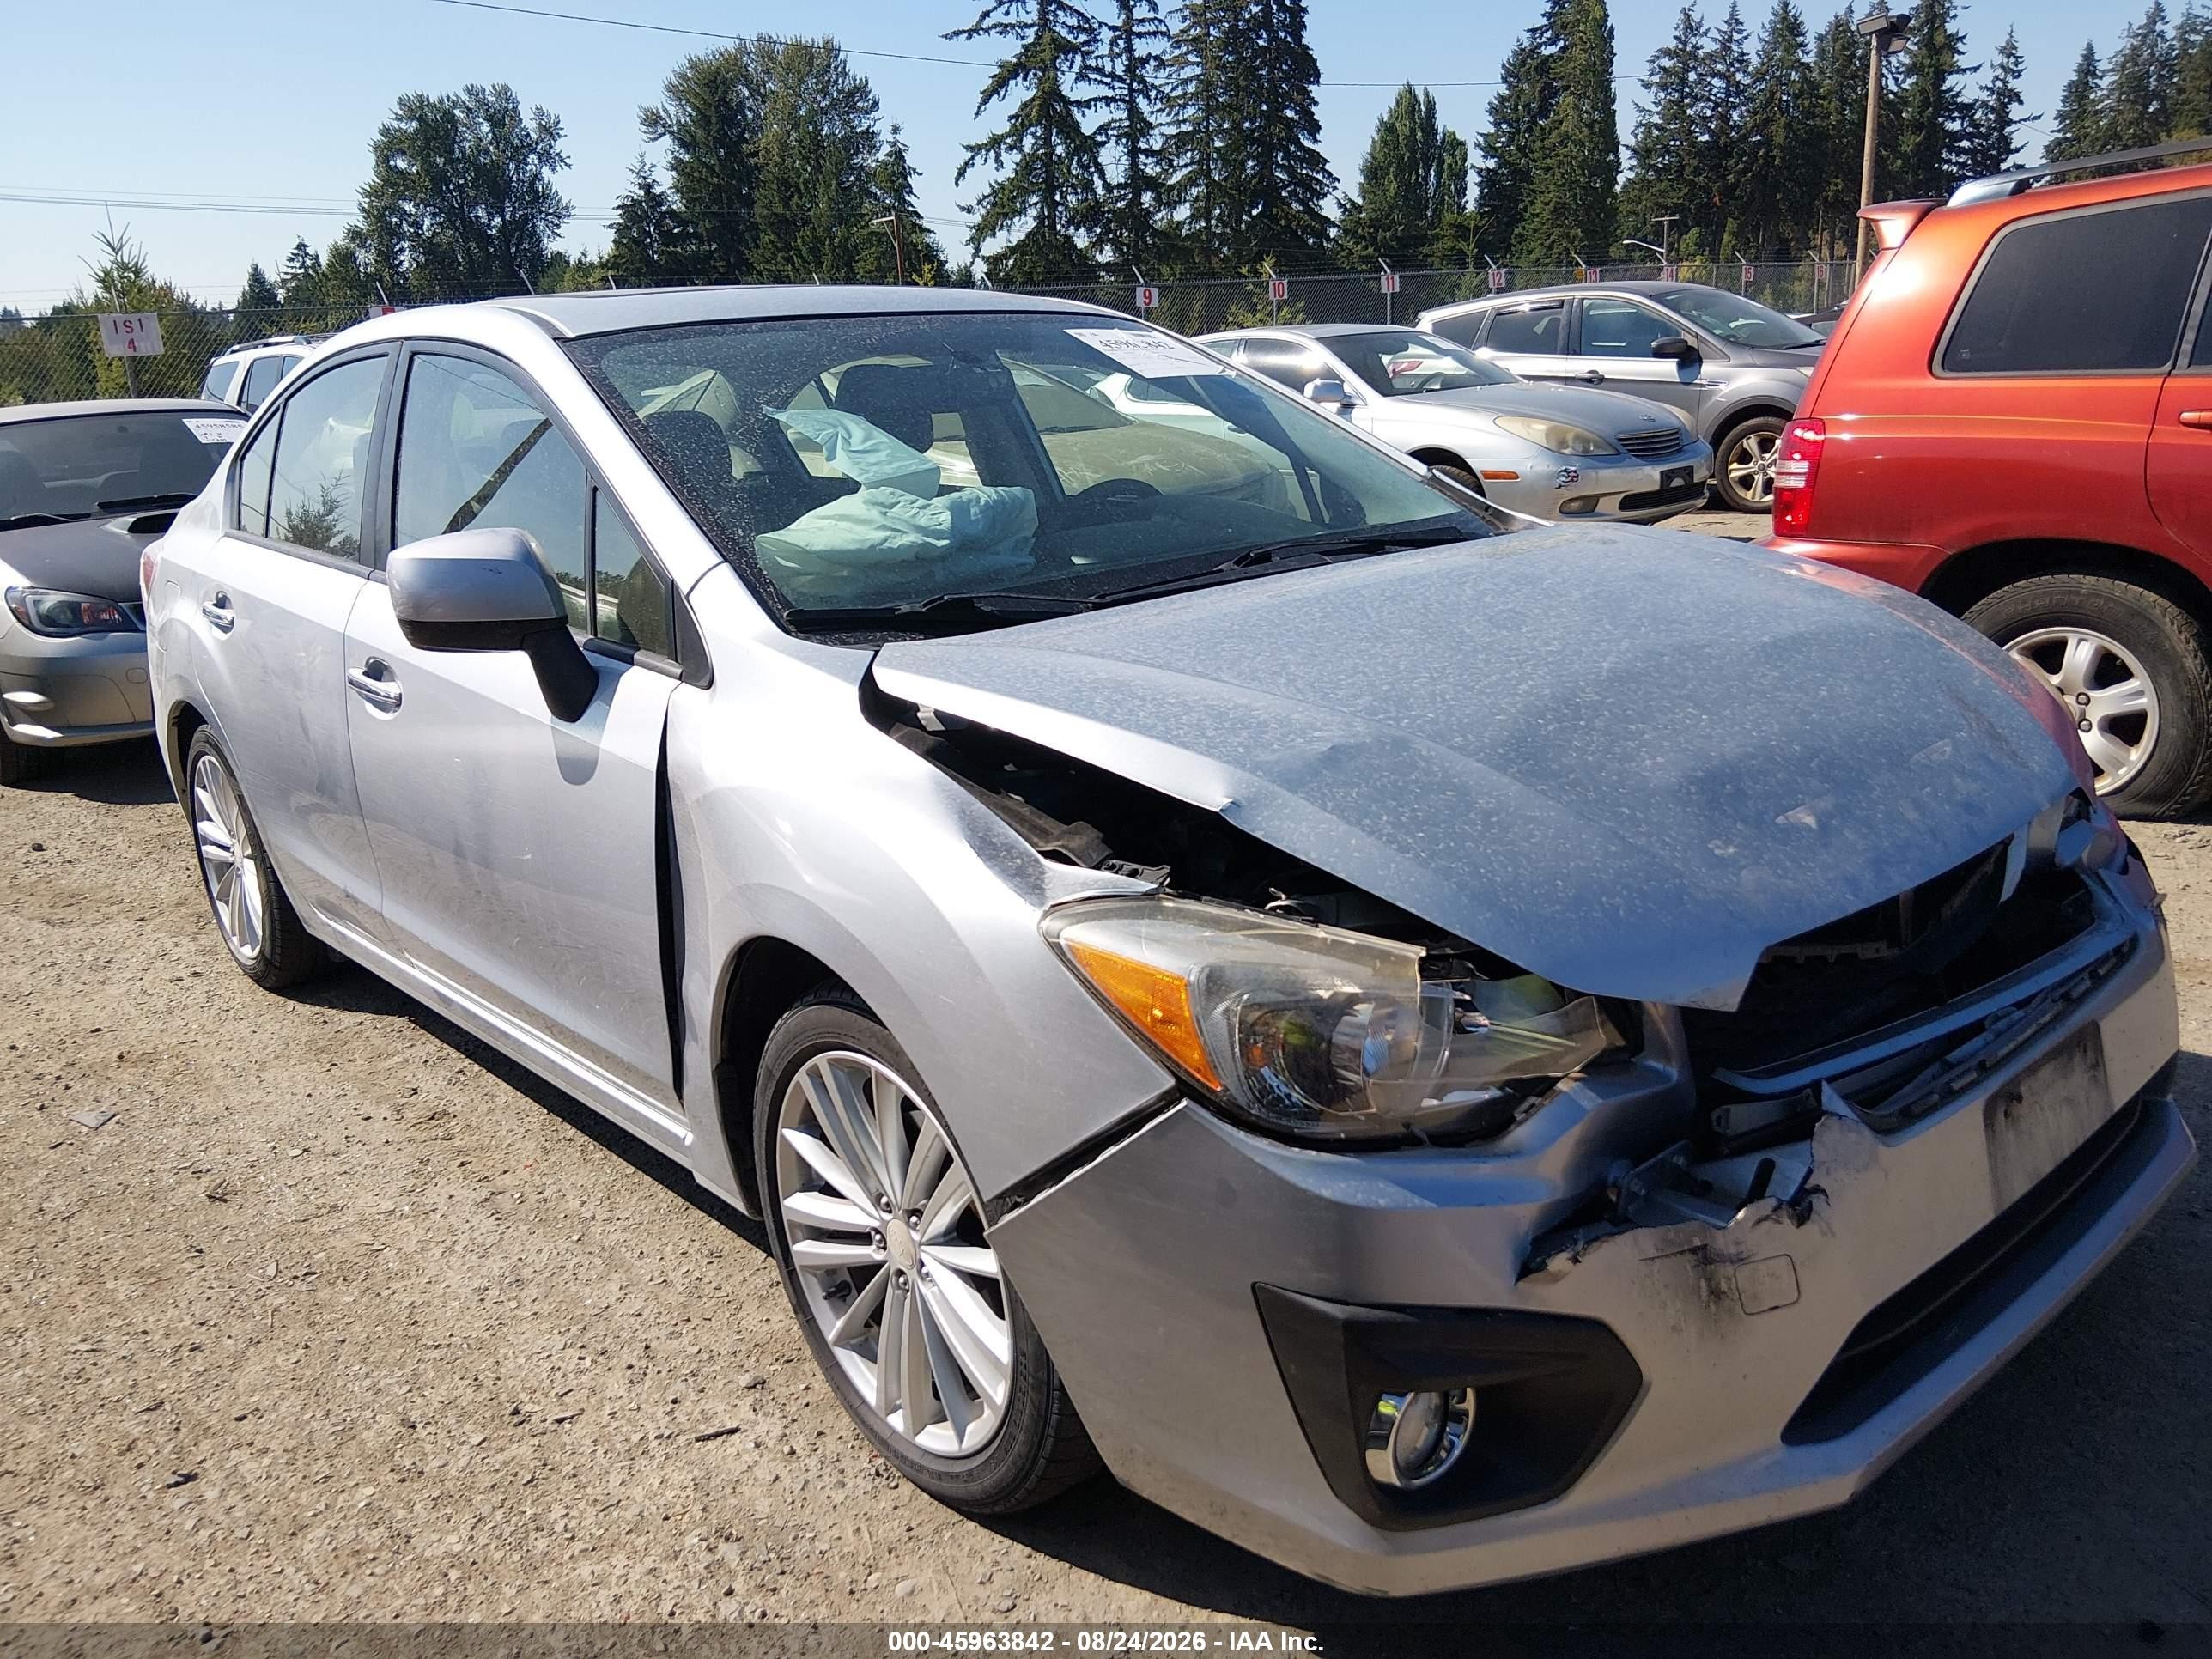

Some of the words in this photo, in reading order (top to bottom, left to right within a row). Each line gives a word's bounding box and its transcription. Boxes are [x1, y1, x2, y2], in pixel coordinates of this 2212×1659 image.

[1589, 270, 1597, 283] 13
[1666, 267, 1674, 281] 14
[1744, 267, 1753, 280] 15
[1817, 265, 1824, 277] 16
[1385, 276, 1395, 292] 11
[1492, 271, 1503, 287] 12
[1143, 288, 1152, 306] 9
[1272, 281, 1285, 298] 10
[127, 337, 137, 352] 4
